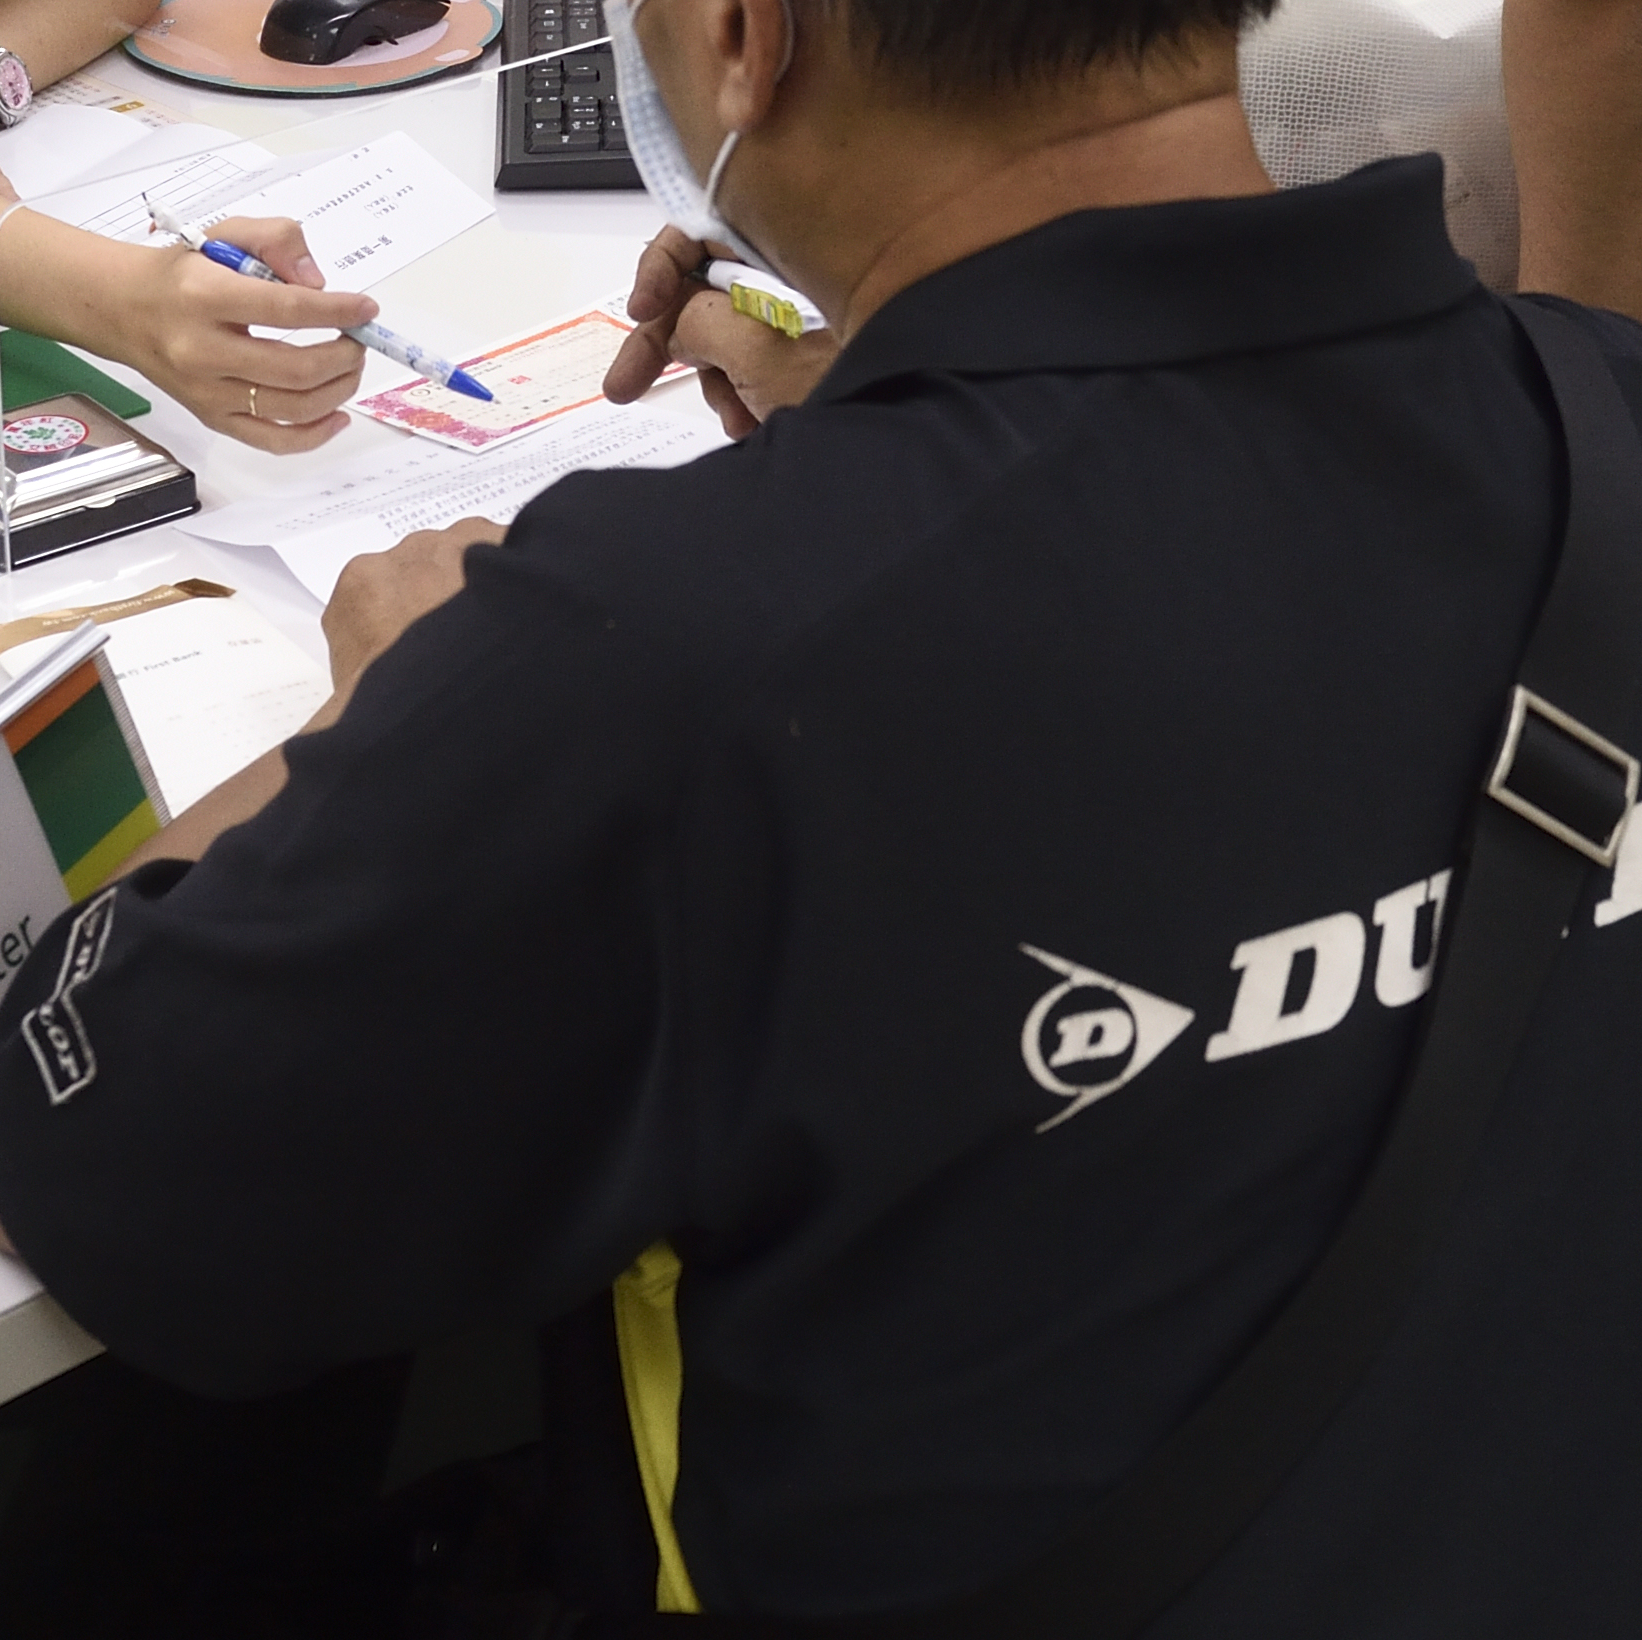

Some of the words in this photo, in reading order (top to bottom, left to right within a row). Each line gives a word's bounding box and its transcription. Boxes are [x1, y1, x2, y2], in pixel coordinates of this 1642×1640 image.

[335, 235, 393, 270] 第一商業銀行
[144, 659, 170, 672] First
[172, 649, 203, 663] Bank
[1051, 1010, 1135, 1065] D
